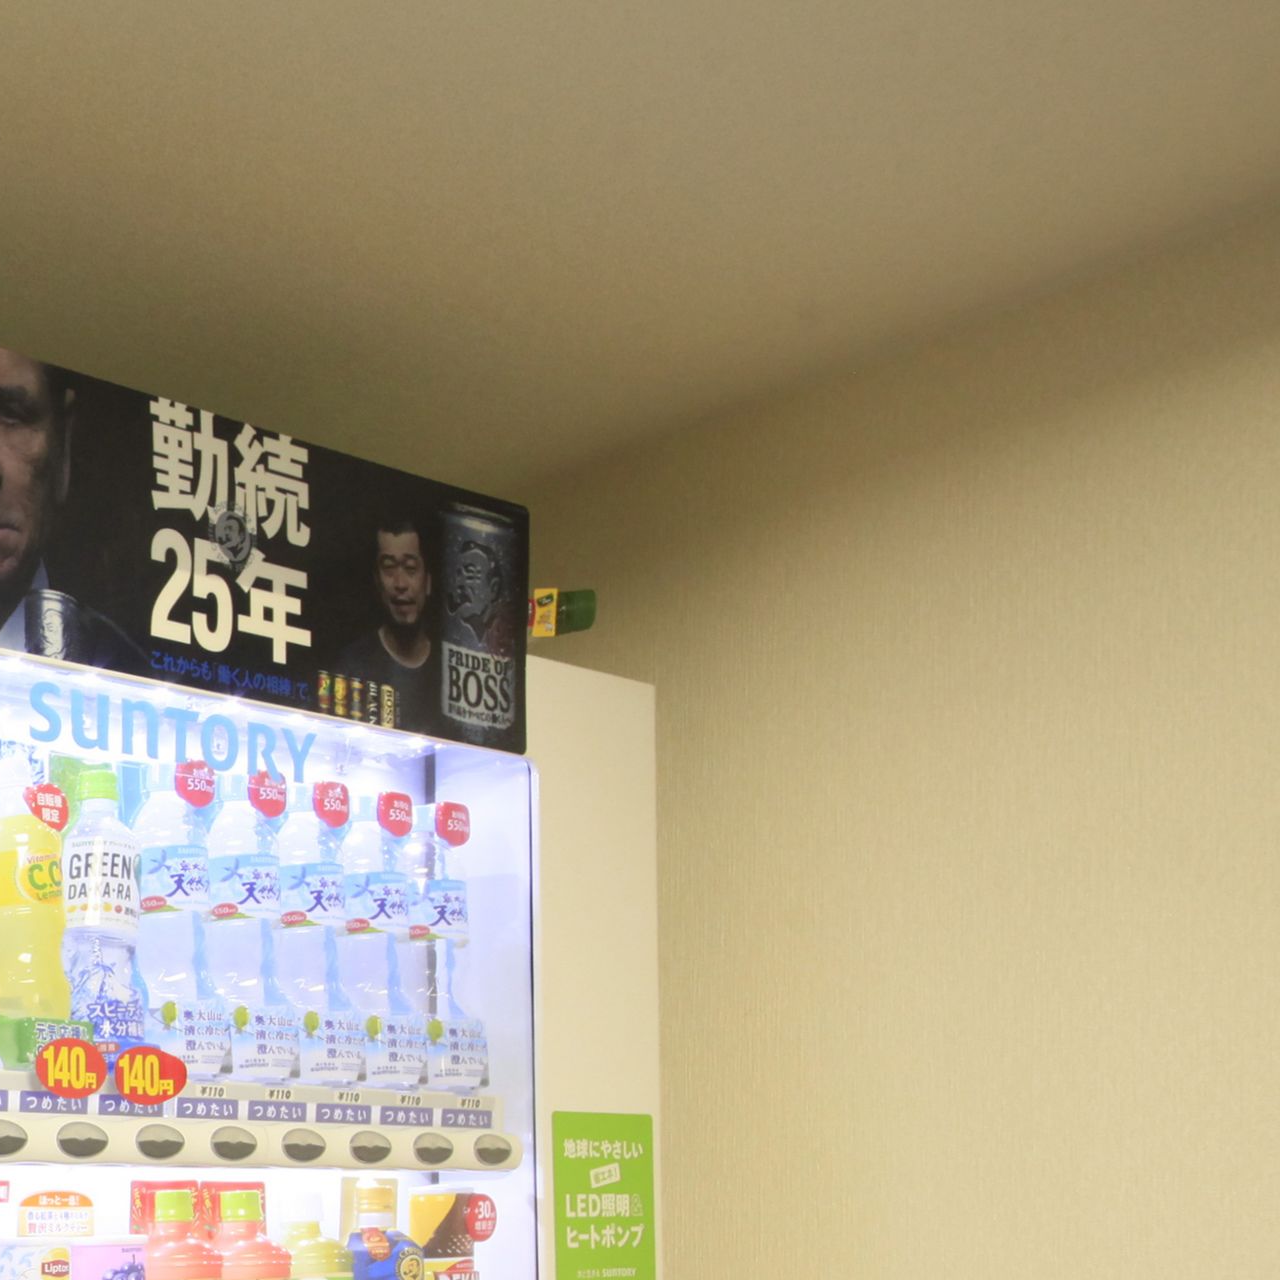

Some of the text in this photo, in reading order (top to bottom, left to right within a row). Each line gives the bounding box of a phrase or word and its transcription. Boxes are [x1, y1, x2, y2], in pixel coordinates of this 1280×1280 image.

[149, 396, 311, 548] 勤続
[149, 527, 312, 664] 25年
[447, 648, 490, 674] PRIDE
[448, 664, 512, 713] BOSS
[43, 1045, 97, 1090] 140円
[118, 1054, 174, 1097] 140円
[199, 1087, 225, 1098] ¥110
[268, 1089, 291, 1100] ¥110
[338, 1092, 359, 1103] ¥110
[183, 1102, 233, 1117] つめたい
[384, 1110, 430, 1124] つめたい
[563, 1138, 643, 1160] 地球にやさしい
[566, 1223, 645, 1250] ヒートポンプ
[602, 1267, 637, 1278] SUNTORY
